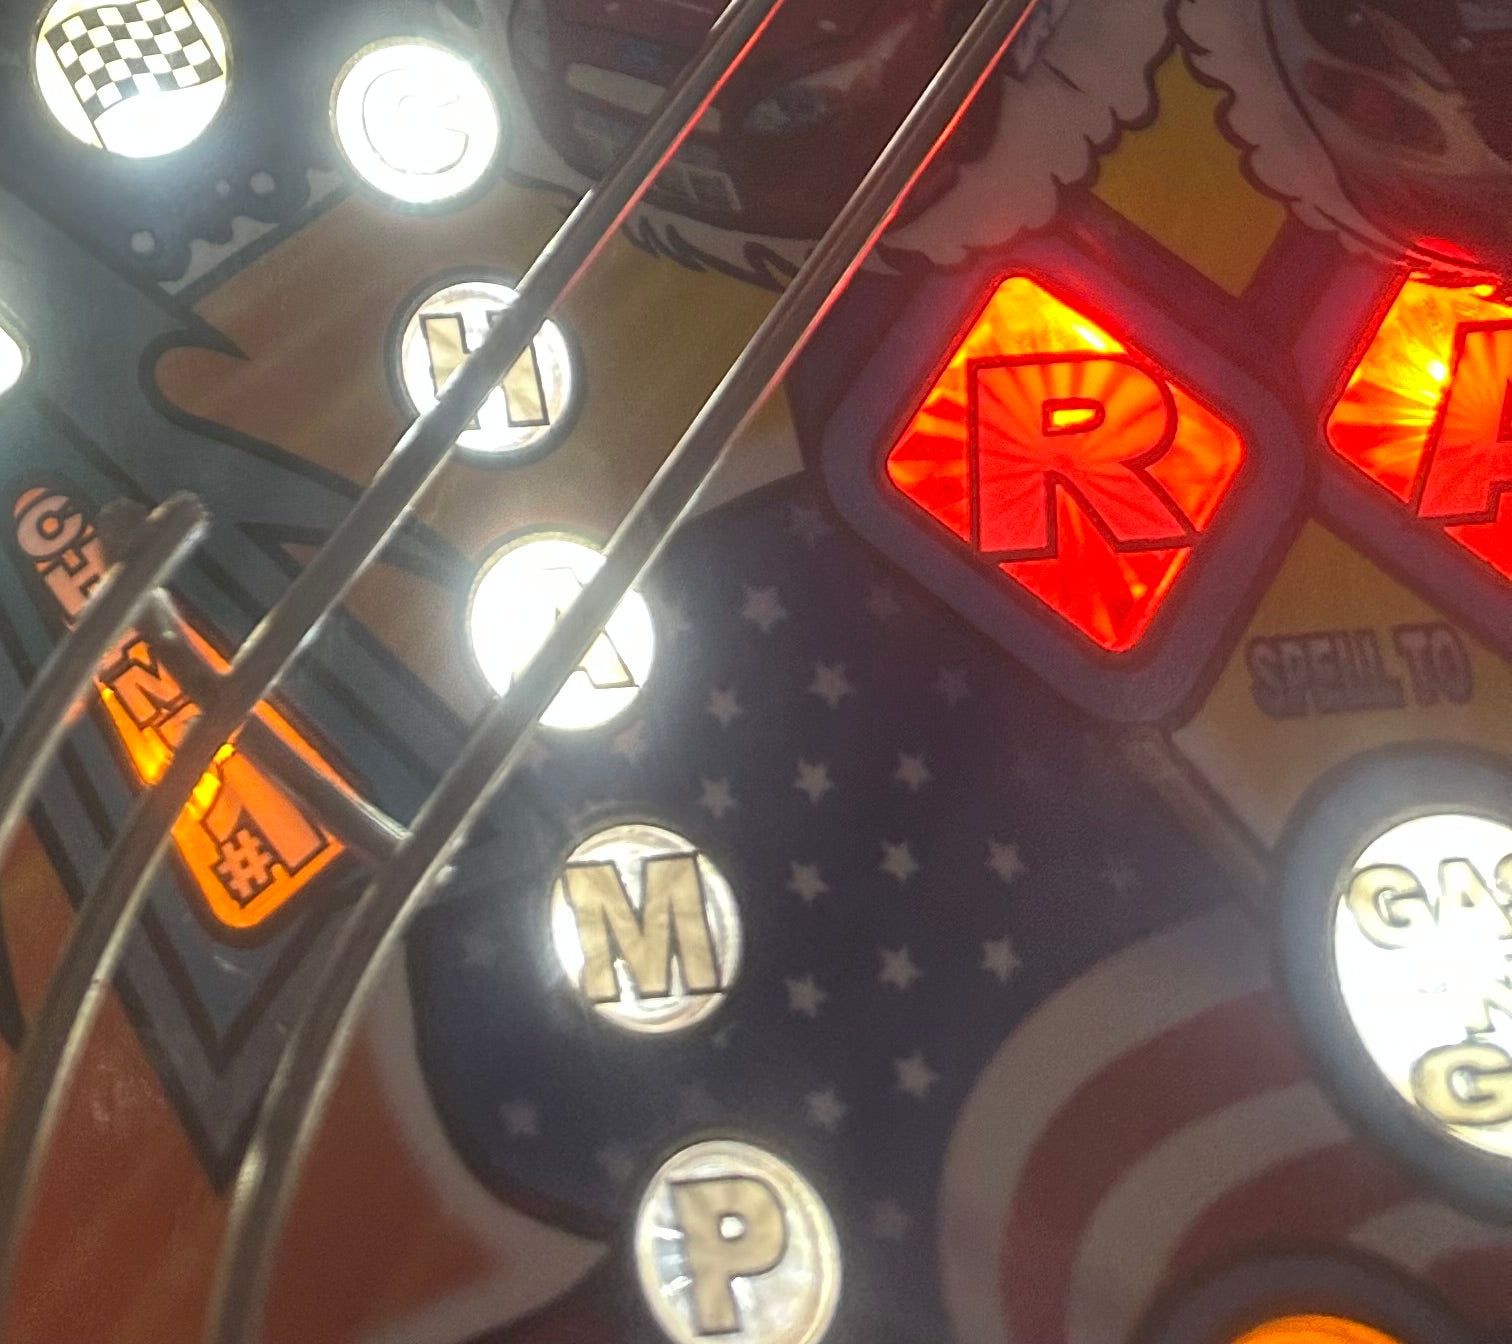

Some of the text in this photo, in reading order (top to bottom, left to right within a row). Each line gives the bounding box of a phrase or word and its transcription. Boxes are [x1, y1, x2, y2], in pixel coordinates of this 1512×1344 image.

[416, 308, 551, 432] H
[966, 352, 1204, 564] R
[1392, 622, 1474, 706] TO
[563, 852, 726, 1005] M
[666, 1176, 789, 1339] P
